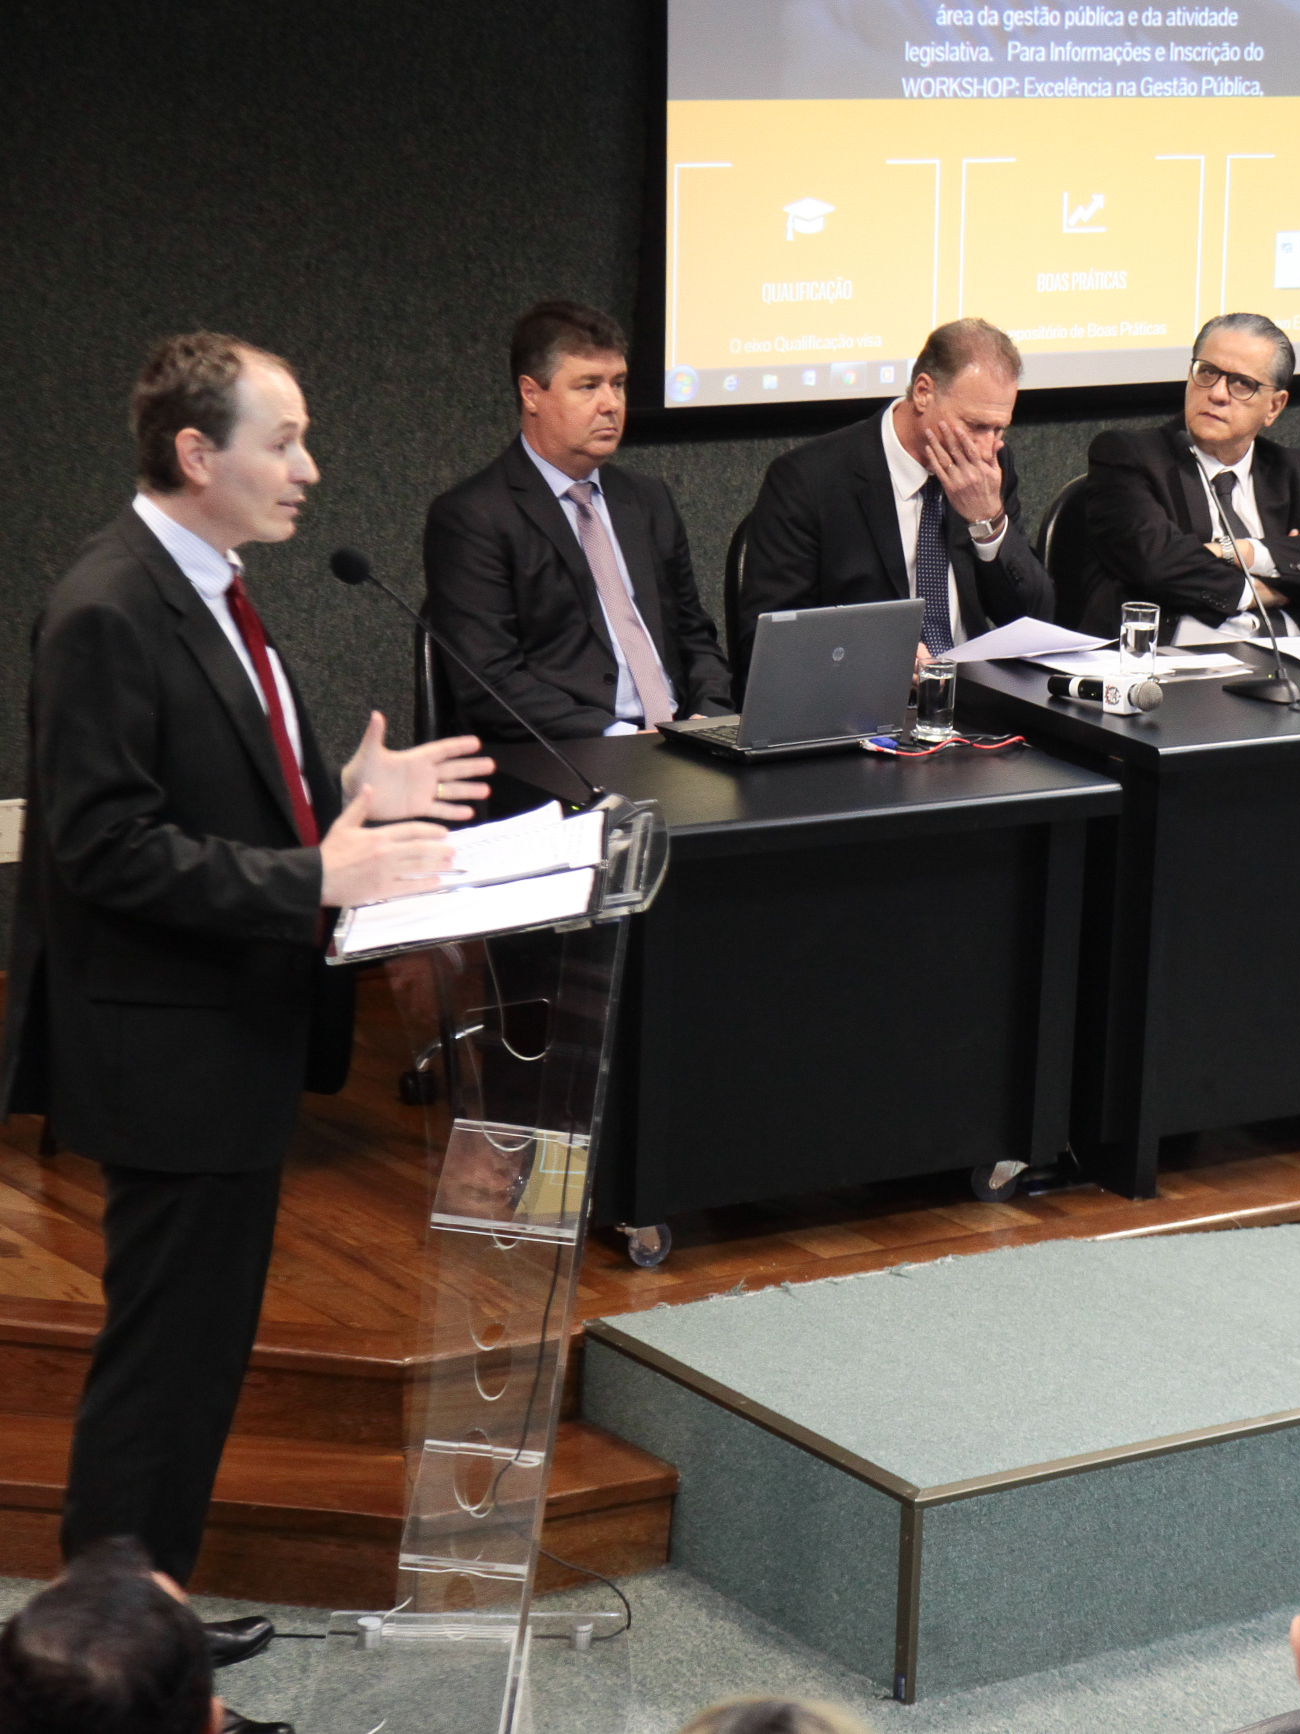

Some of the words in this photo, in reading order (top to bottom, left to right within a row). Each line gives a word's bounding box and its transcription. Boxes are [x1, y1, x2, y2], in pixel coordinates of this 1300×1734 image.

[936, 6, 973, 26] área
[977, 6, 999, 26] da
[1002, 6, 1060, 31] gestão
[1064, 5, 1124, 30] pública
[1128, 10, 1138, 26] e
[1142, 7, 1162, 26] da
[1165, 7, 1238, 27] atividade
[905, 41, 993, 67] legislativa.
[1007, 41, 1046, 62] Para
[1049, 41, 1151, 66] Informações
[1155, 45, 1166, 62] e
[1169, 41, 1241, 66] Inscrição
[1244, 42, 1264, 62] do
[901, 77, 1019, 98] WORKSHOP:
[1024, 76, 1112, 98] Excelência
[1116, 80, 1137, 97] na
[1140, 77, 1198, 97] Gestão
[762, 277, 852, 304] QUALIFICAÇÃO
[1036, 272, 1069, 293] BOAS
[1073, 268, 1127, 290] PRÁTICAS
[1070, 323, 1085, 339] de
[1087, 322, 1117, 338] Boas
[1119, 320, 1167, 337] Práticas
[729, 338, 742, 353] O
[744, 339, 771, 353] eixo
[774, 335, 854, 354] Qualificação
[857, 334, 882, 348] visa
